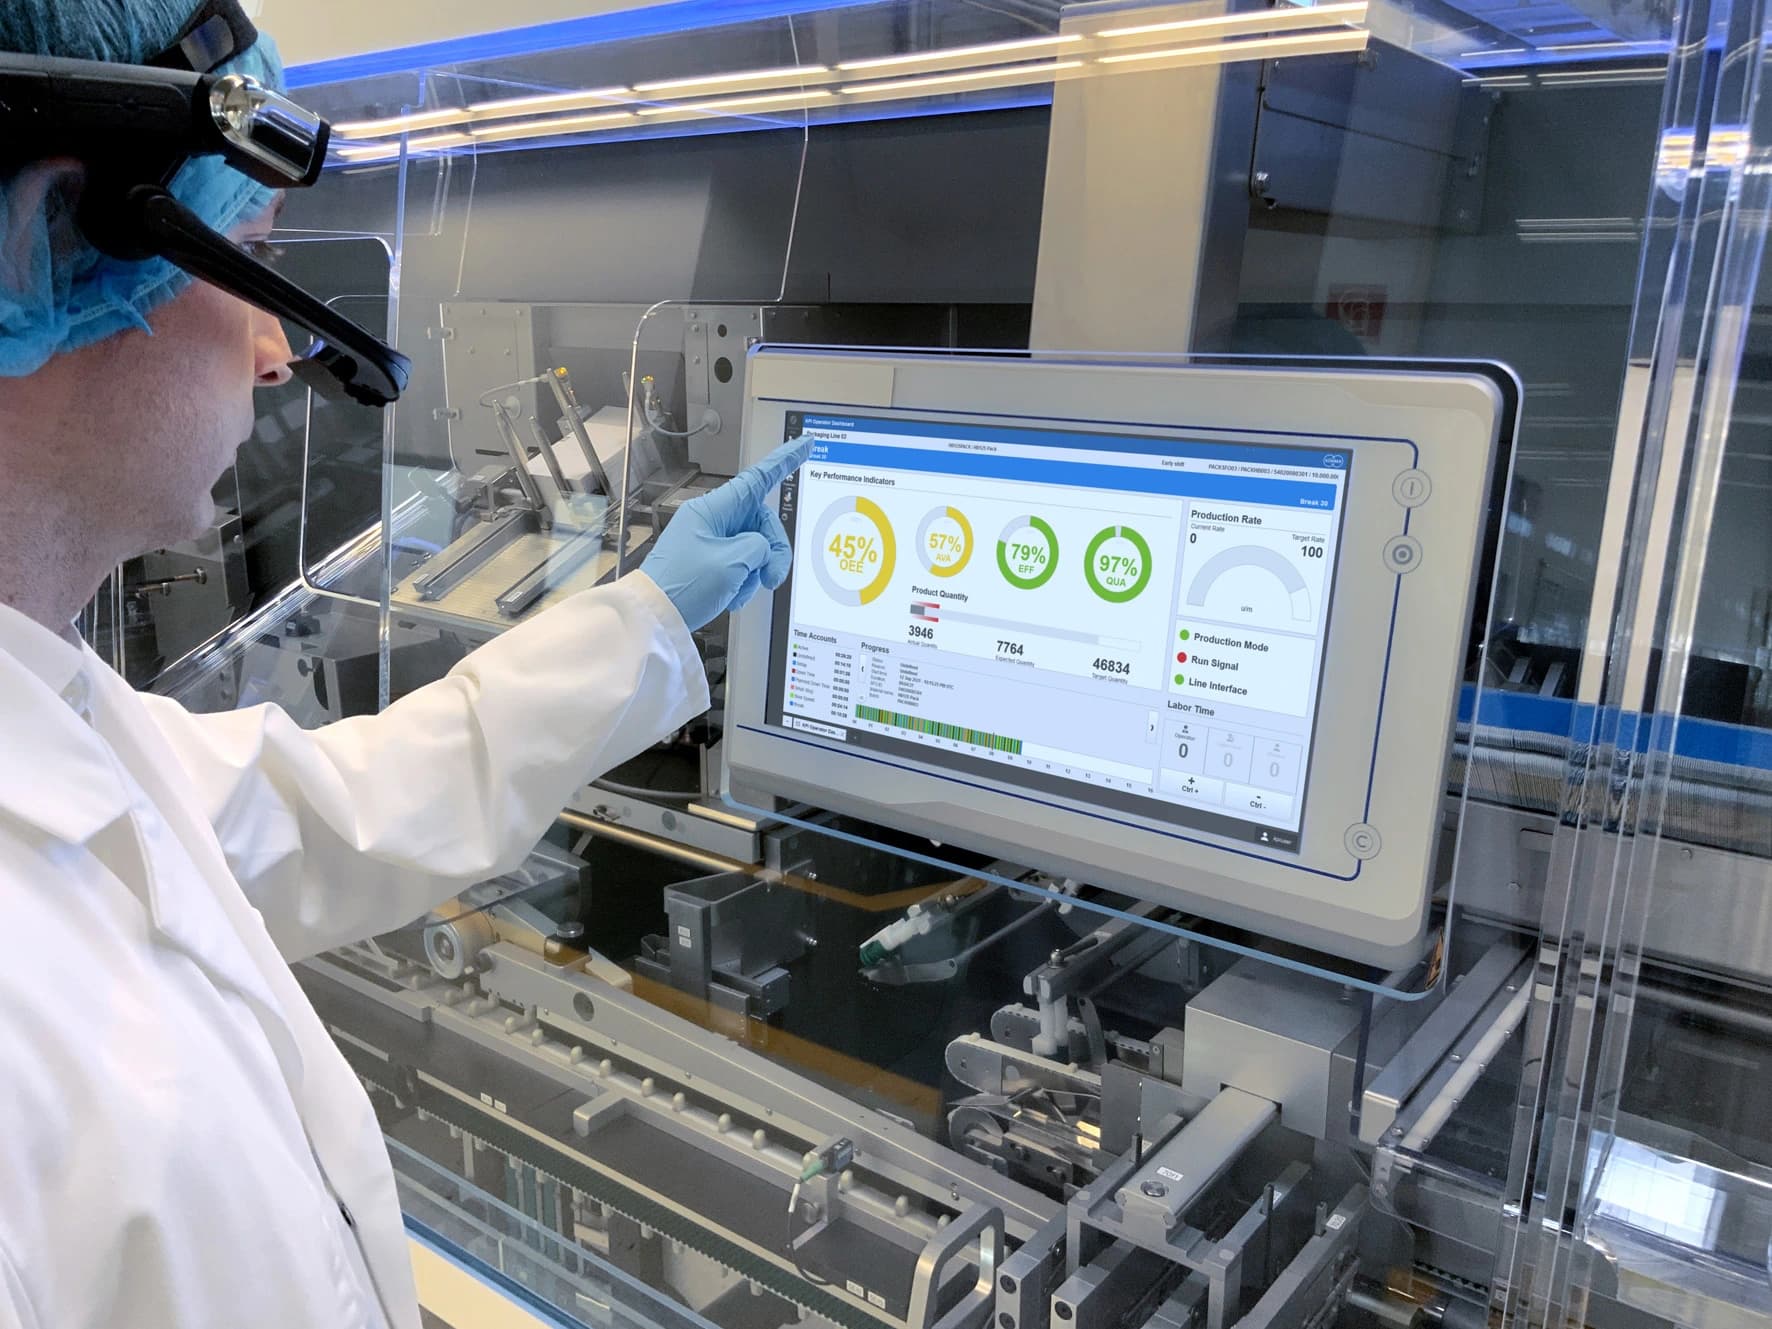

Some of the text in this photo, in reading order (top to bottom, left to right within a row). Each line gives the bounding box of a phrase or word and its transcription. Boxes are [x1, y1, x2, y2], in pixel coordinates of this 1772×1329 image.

[830, 431, 841, 439] Line
[810, 470, 895, 486] Key Performance Indicators
[1191, 510, 1263, 525] Production Rate
[929, 533, 961, 553] 57%
[1190, 533, 1197, 543] 0
[1292, 534, 1310, 542] Target
[828, 533, 878, 563] 45%
[1011, 543, 1046, 564] 79%
[1301, 546, 1323, 558] 100
[935, 553, 951, 562] AVA
[839, 559, 864, 573] OEE
[1018, 564, 1034, 574] EFF
[1099, 555, 1138, 576] 97%
[1106, 577, 1126, 587] QUA
[911, 585, 969, 602] Product Quantity
[794, 629, 837, 644] Time Accounts
[908, 625, 934, 640] 3946
[861, 641, 890, 654] Progress
[996, 640, 1024, 656] 7764
[1194, 632, 1269, 652] Production Mode
[1014, 658, 1035, 668] Quantity
[1092, 657, 1131, 675] 46834
[1191, 655, 1239, 671] Run Signal
[1092, 672, 1128, 685] Target Quantity
[1188, 677, 1248, 696] Line Interface
[1167, 700, 1215, 717] Labor Time
[1179, 743, 1188, 758] 0
[1223, 752, 1233, 767] 0
[1270, 762, 1279, 777] 0
[1181, 785, 1194, 793] Ctrl
[1249, 800, 1262, 809] Ctrl
